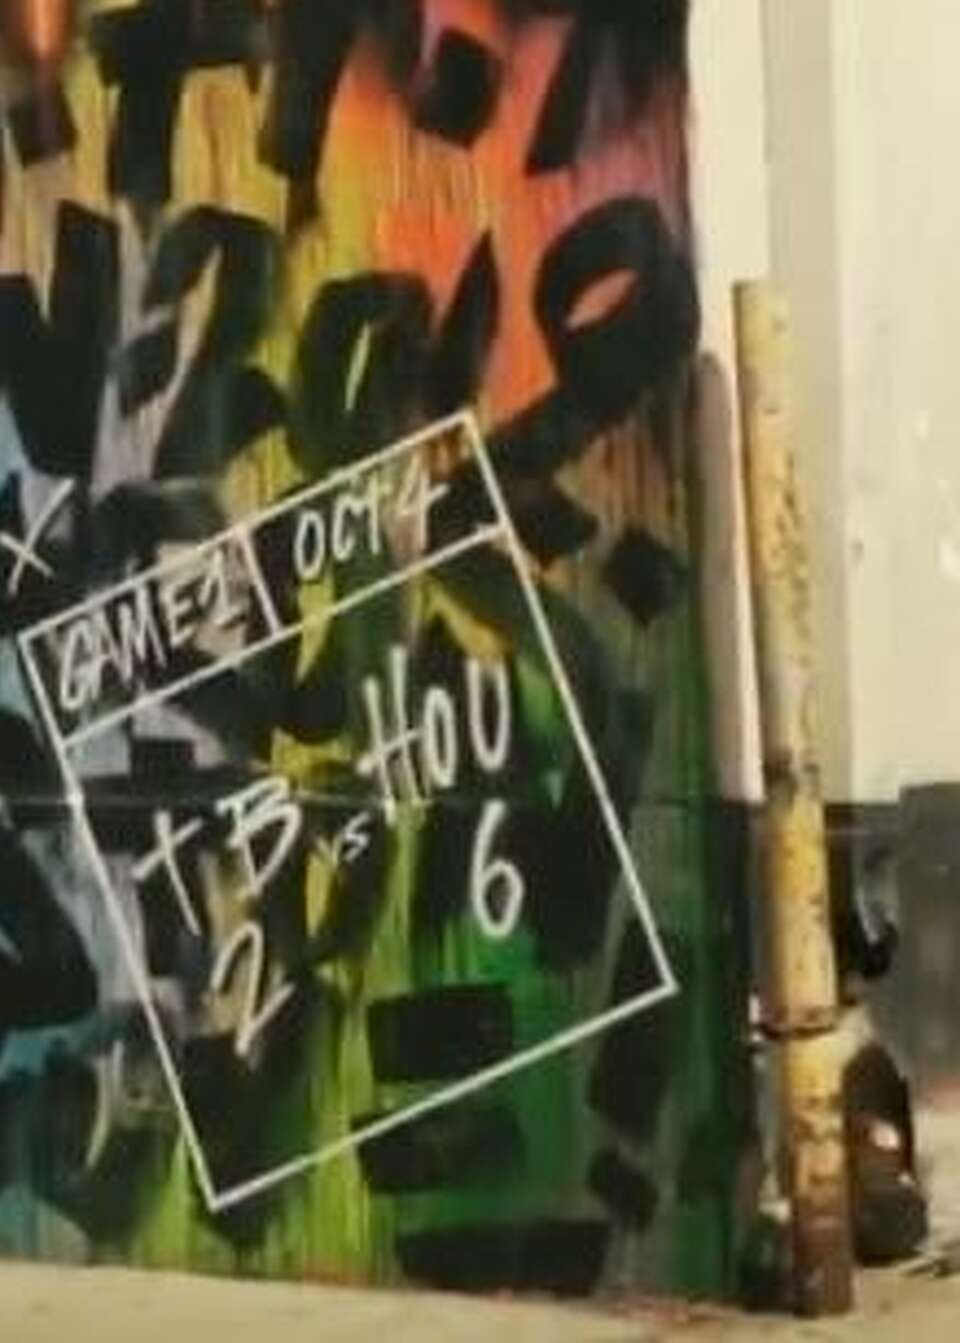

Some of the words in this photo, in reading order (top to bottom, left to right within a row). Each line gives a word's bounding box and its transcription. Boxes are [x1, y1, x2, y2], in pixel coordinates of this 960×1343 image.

[356, 646, 512, 826] HOU
[210, 920, 298, 1056] 2
[470, 799, 526, 939] 6
